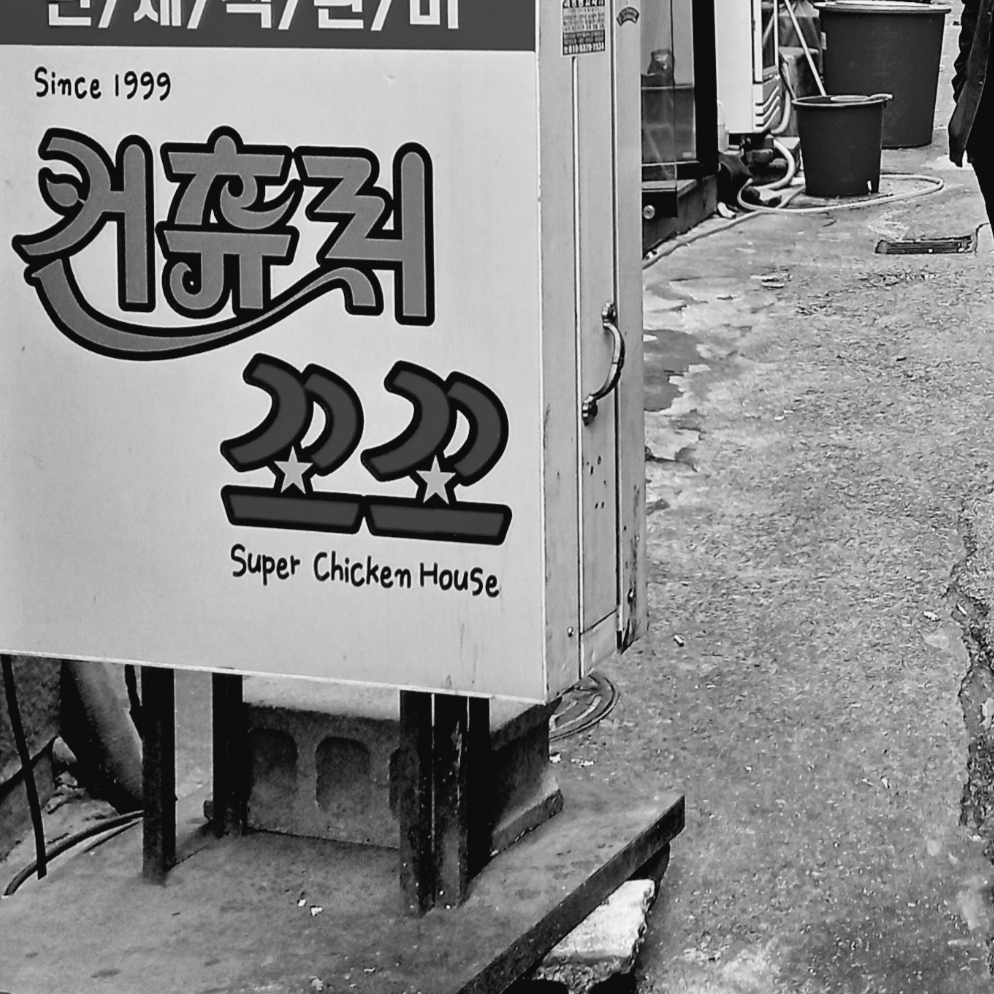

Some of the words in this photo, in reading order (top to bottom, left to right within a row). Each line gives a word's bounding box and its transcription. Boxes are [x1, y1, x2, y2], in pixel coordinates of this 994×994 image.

[34, 66, 102, 99] Since
[114, 71, 172, 101] 1999
[219, 352, 512, 546] 꼬꼬
[229, 543, 301, 586] Super
[313, 550, 412, 589] Chicken
